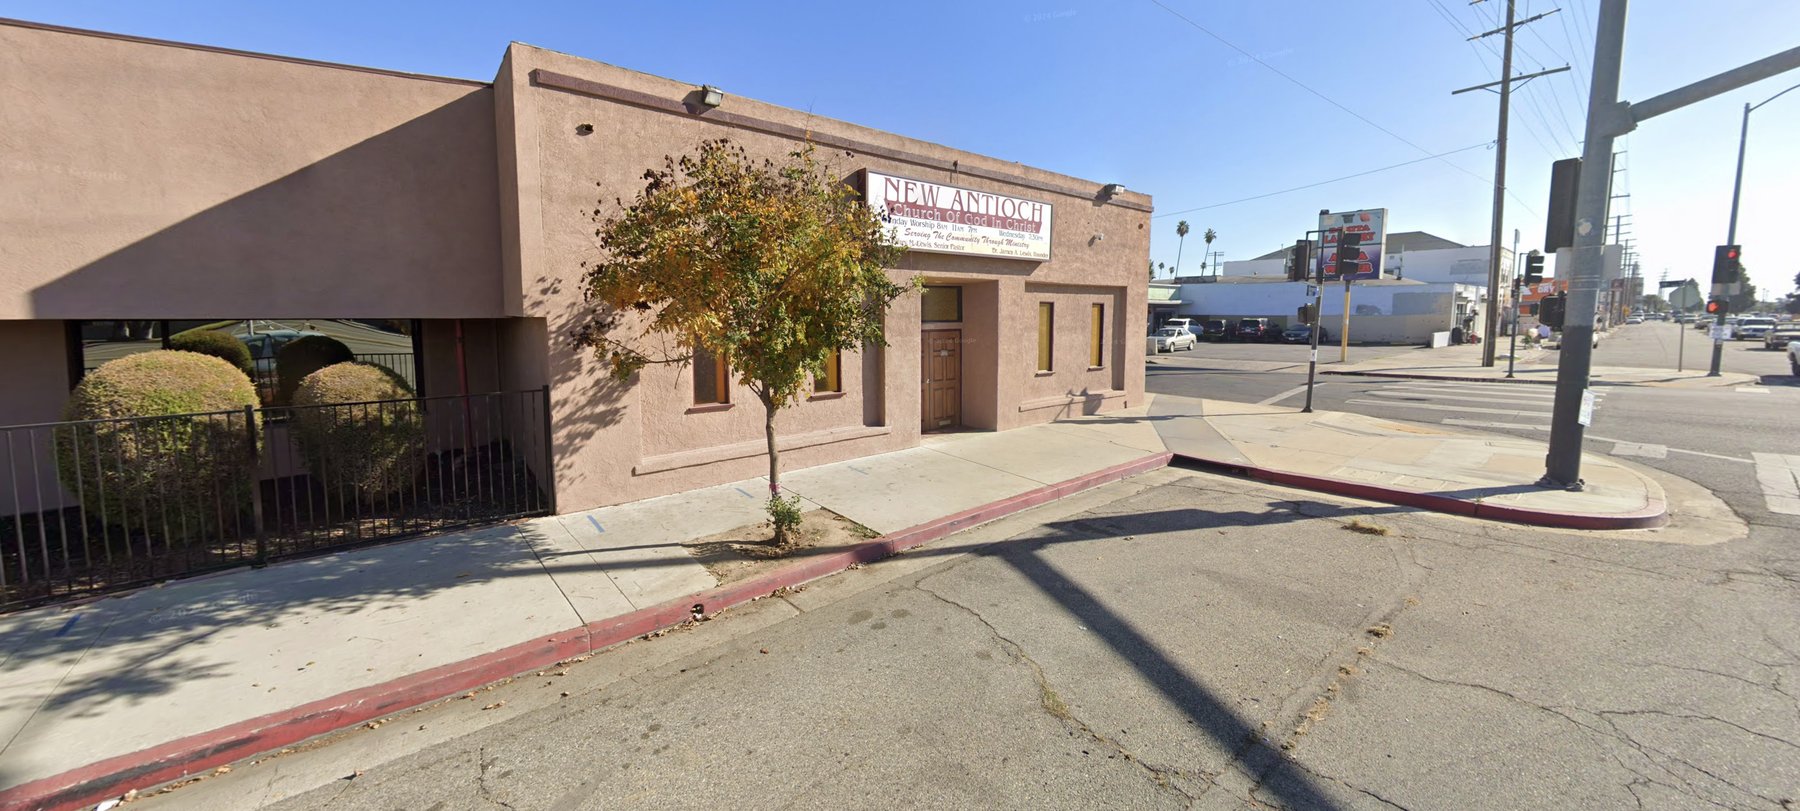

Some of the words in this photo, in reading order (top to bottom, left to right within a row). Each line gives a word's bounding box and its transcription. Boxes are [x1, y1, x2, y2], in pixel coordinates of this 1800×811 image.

[884, 177, 940, 207] NEW
[951, 189, 1043, 223] ANTIOCH
[893, 203, 940, 220] Church
[946, 210, 961, 223] Of
[964, 213, 988, 227] God
[991, 216, 1002, 229] In
[1006, 219, 1036, 233] Christ
[910, 219, 935, 230] Worship
[904, 228, 931, 240] Serving
[933, 231, 944, 240] The
[945, 232, 980, 244] Community
